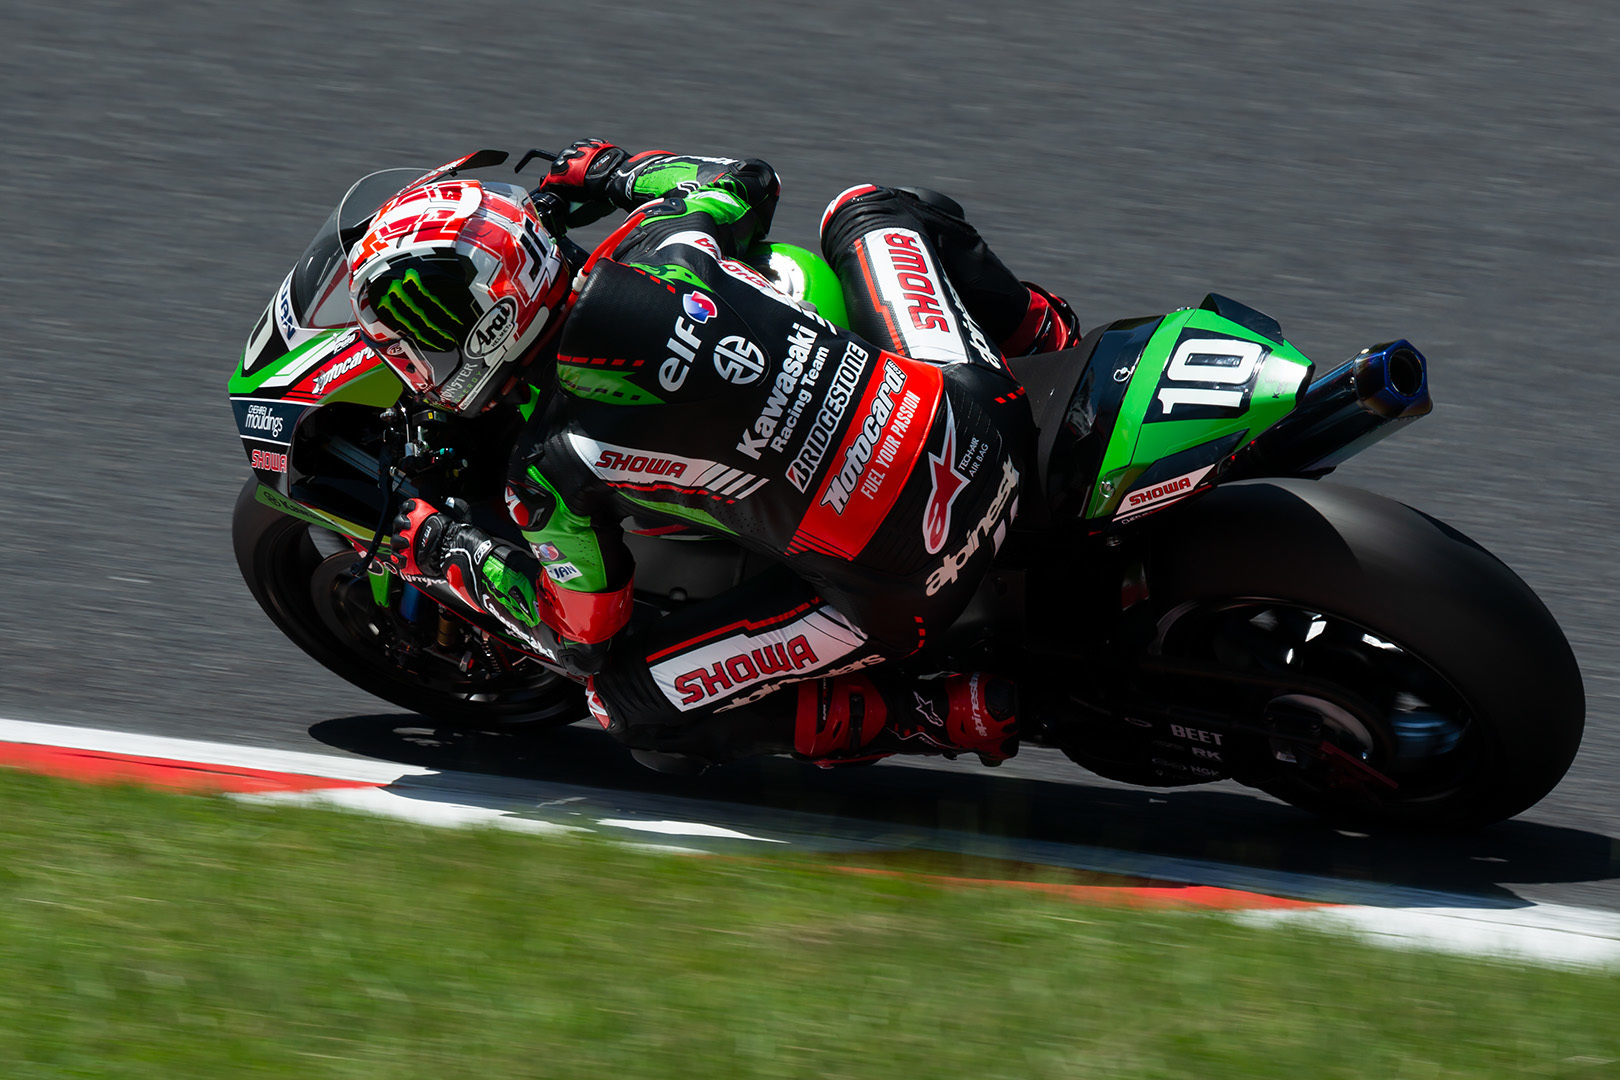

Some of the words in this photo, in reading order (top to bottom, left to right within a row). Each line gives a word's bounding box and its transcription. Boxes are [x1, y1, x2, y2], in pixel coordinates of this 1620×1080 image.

[694, 238, 770, 288] SHOA
[883, 232, 951, 333] SHOWA
[475, 303, 511, 346] Arai
[658, 315, 702, 392] elf
[1157, 338, 1264, 415] 10
[736, 322, 818, 461] Kawasaki
[769, 389, 813, 453] Racing
[800, 346, 830, 387] Team
[245, 407, 284, 438] mouldings
[785, 341, 869, 494] BRIDGESTONE
[251, 448, 287, 473] SHOWA
[595, 450, 688, 478] SHOWA
[860, 468, 886, 500] FUEL
[875, 434, 901, 469] YOUR
[890, 389, 921, 439] PASSION
[958, 436, 980, 471] TECH-AIR
[969, 462, 981, 478] AIR
[977, 443, 989, 463] BAG
[1129, 477, 1191, 506] SHOWA
[925, 454, 1020, 597] alpinest
[674, 634, 820, 706] SHOWA
[1170, 723, 1224, 747] BEET
[1192, 746, 1224, 763] RK
